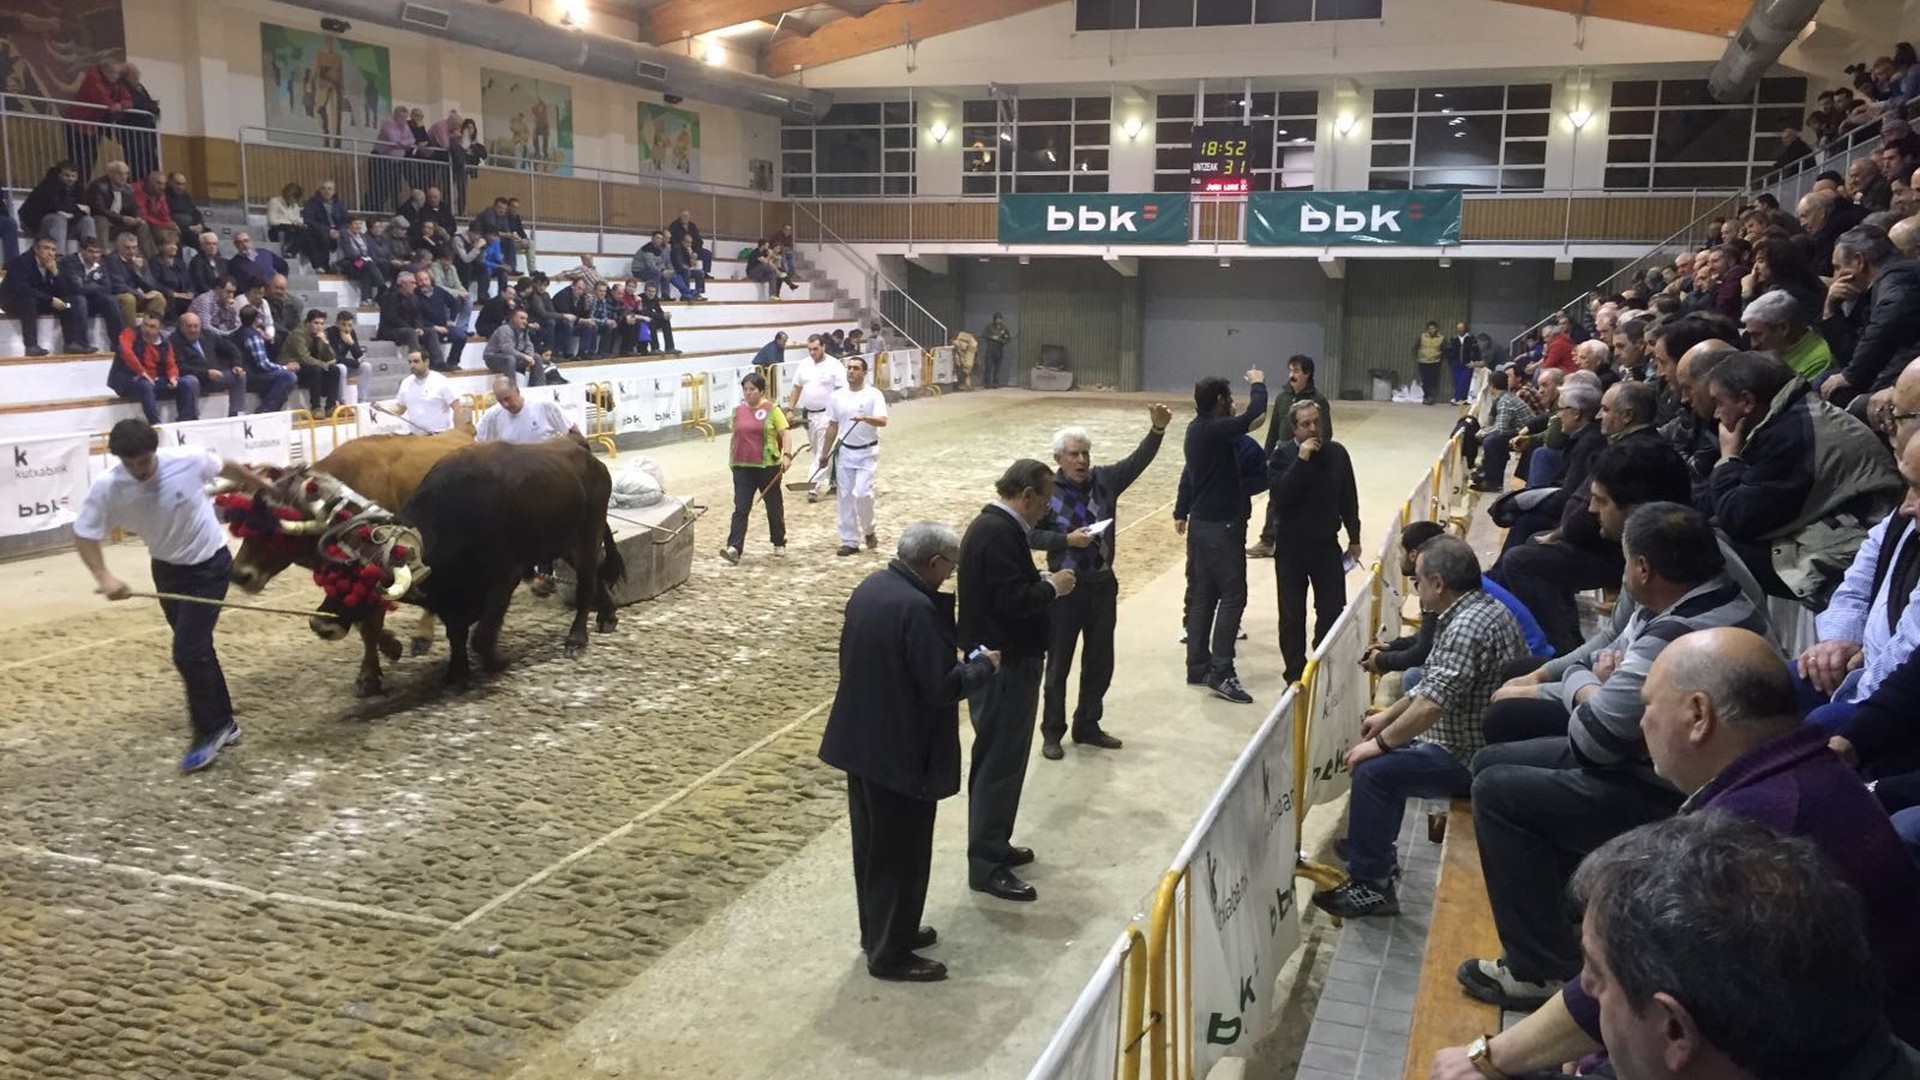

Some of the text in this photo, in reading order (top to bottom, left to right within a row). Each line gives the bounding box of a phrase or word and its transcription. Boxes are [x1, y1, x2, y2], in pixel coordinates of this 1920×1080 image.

[1201, 141, 1247, 156] 18:52
[1223, 160, 1246, 175] 31
[1047, 205, 1137, 232] bbk
[1300, 205, 1401, 232] bbk
[370, 408, 378, 424] k
[177, 430, 186, 446] k
[244, 421, 254, 439] k
[14, 445, 28, 467] k
